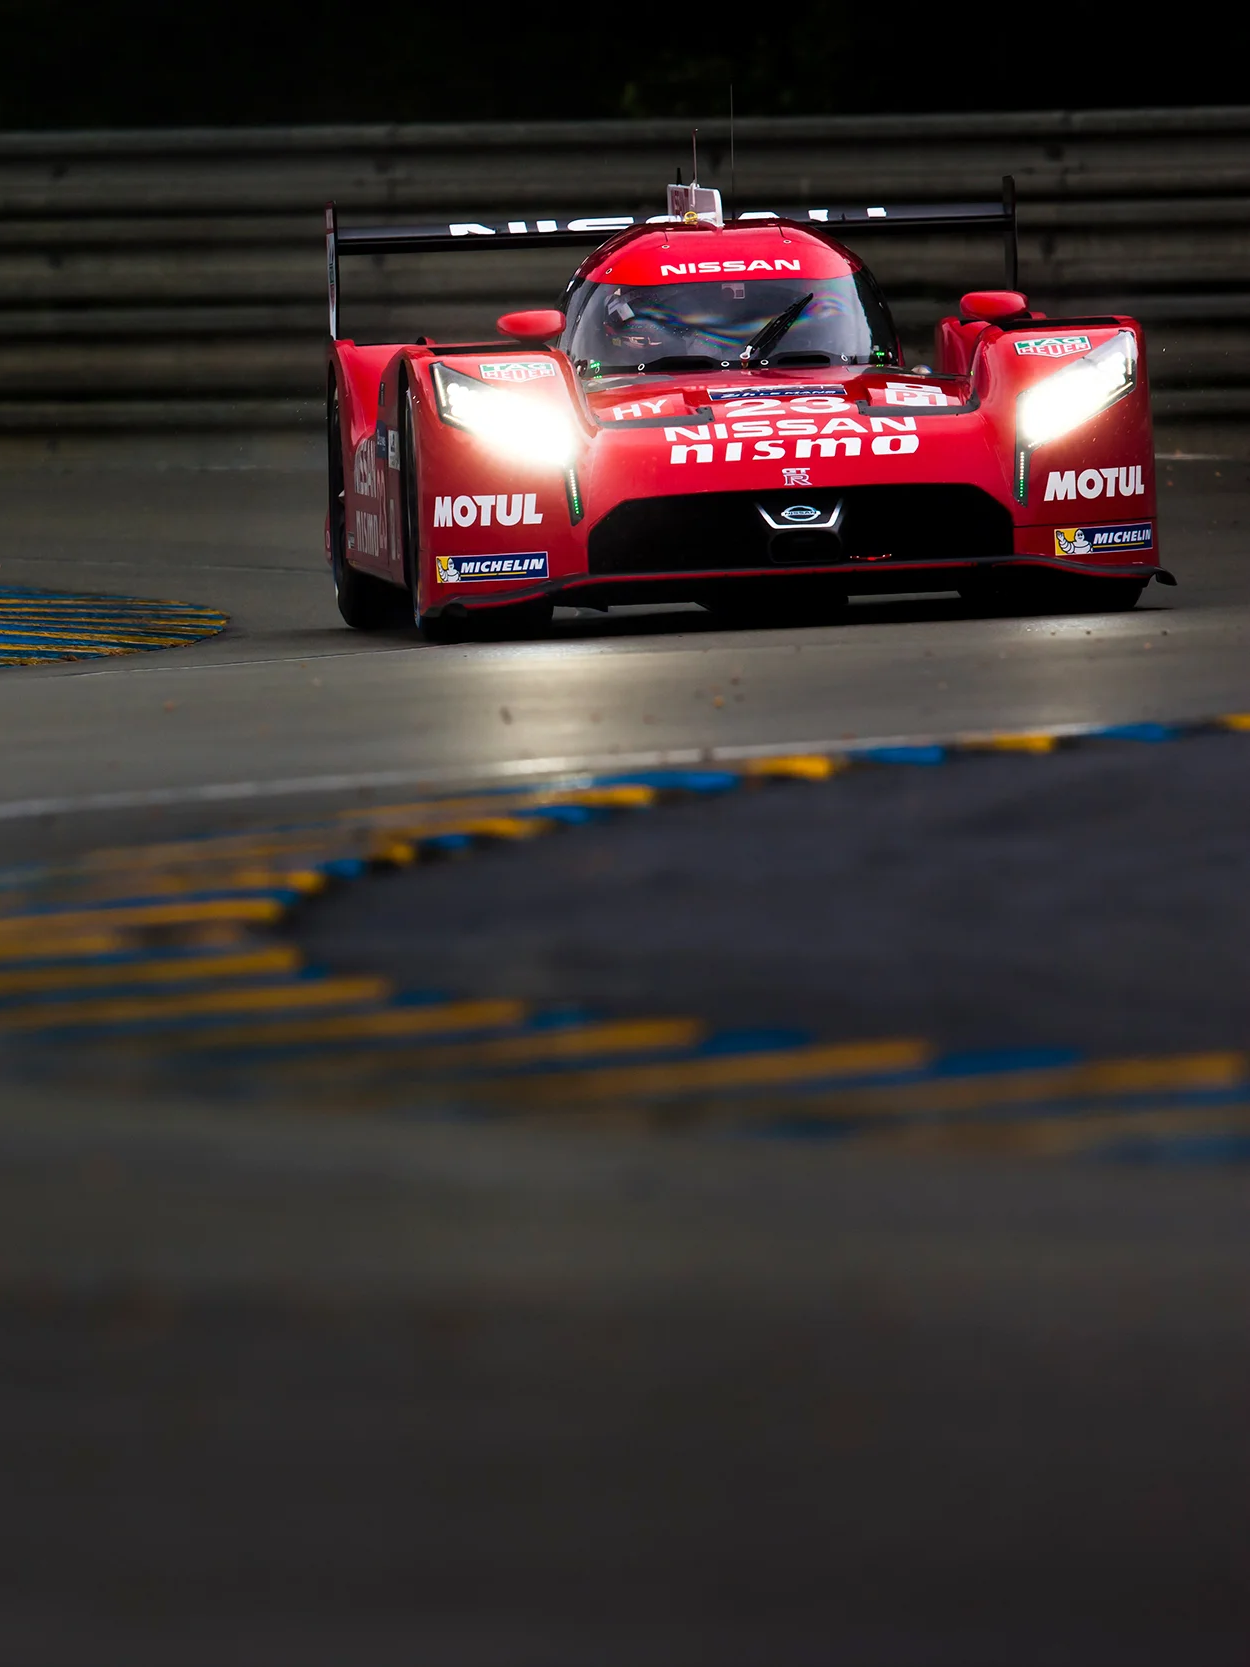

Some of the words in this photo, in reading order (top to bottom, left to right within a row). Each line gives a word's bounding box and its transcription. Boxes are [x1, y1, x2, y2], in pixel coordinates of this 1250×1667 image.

[660, 259, 801, 277] NISSAN
[1020, 336, 1082, 348] TAG
[1021, 343, 1088, 356] HEUER
[484, 363, 548, 371] TAG
[486, 369, 553, 380] HEUER
[613, 399, 667, 421] HY
[726, 396, 851, 418] 23
[664, 416, 918, 442] NISSAN
[670, 433, 920, 465] nismo
[1044, 465, 1145, 502] MOTUL
[433, 493, 544, 528] MOTUL
[1093, 529, 1152, 545] MICHELIN
[460, 558, 545, 574] MICHELIN
